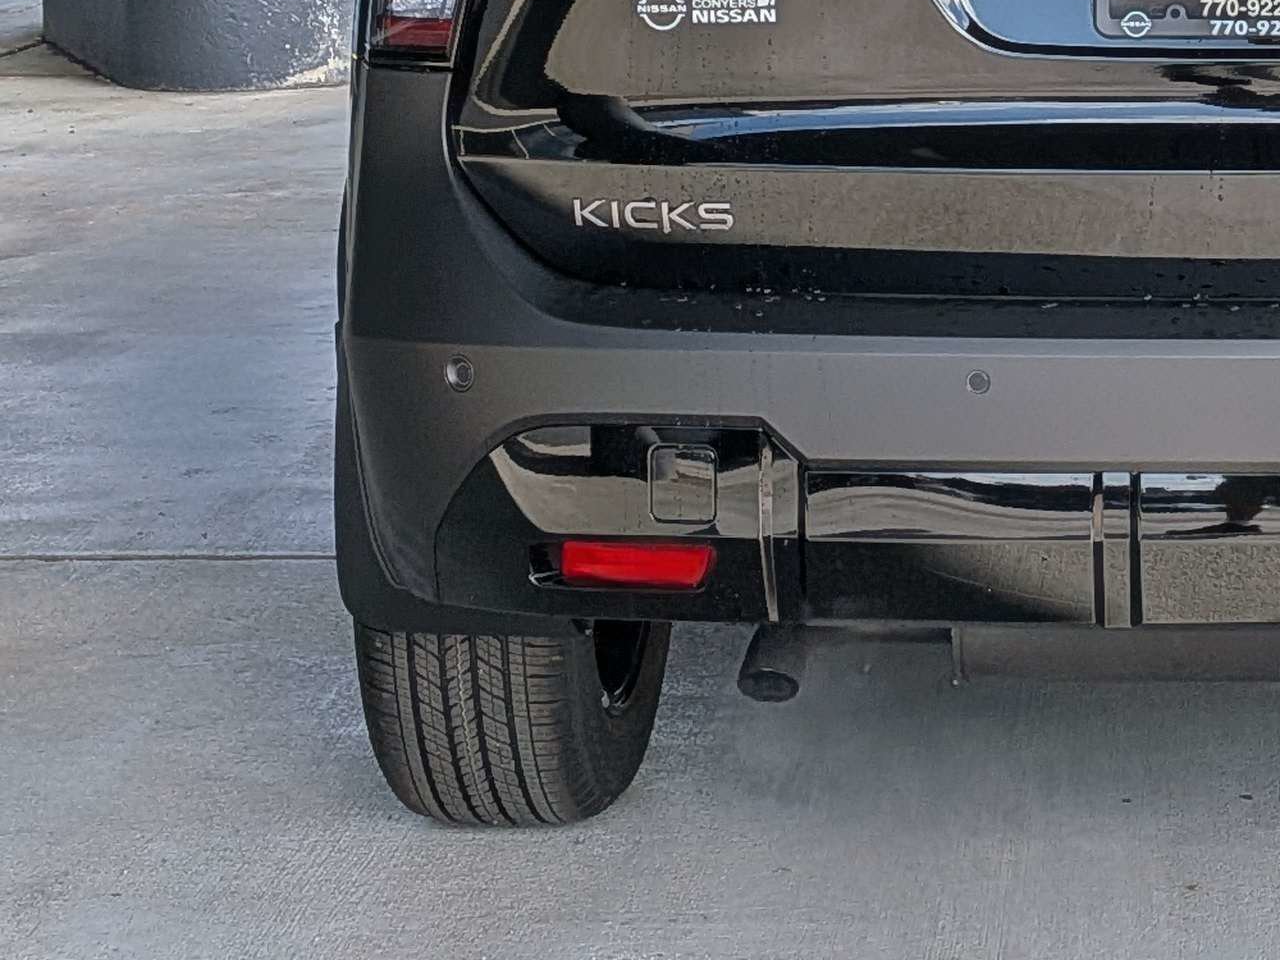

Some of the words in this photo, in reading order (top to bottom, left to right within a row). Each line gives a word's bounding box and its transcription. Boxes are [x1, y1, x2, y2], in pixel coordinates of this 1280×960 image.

[637, 4, 687, 13] NISSAN
[692, 9, 777, 23] NISSAN
[573, 198, 735, 232] KICKS
